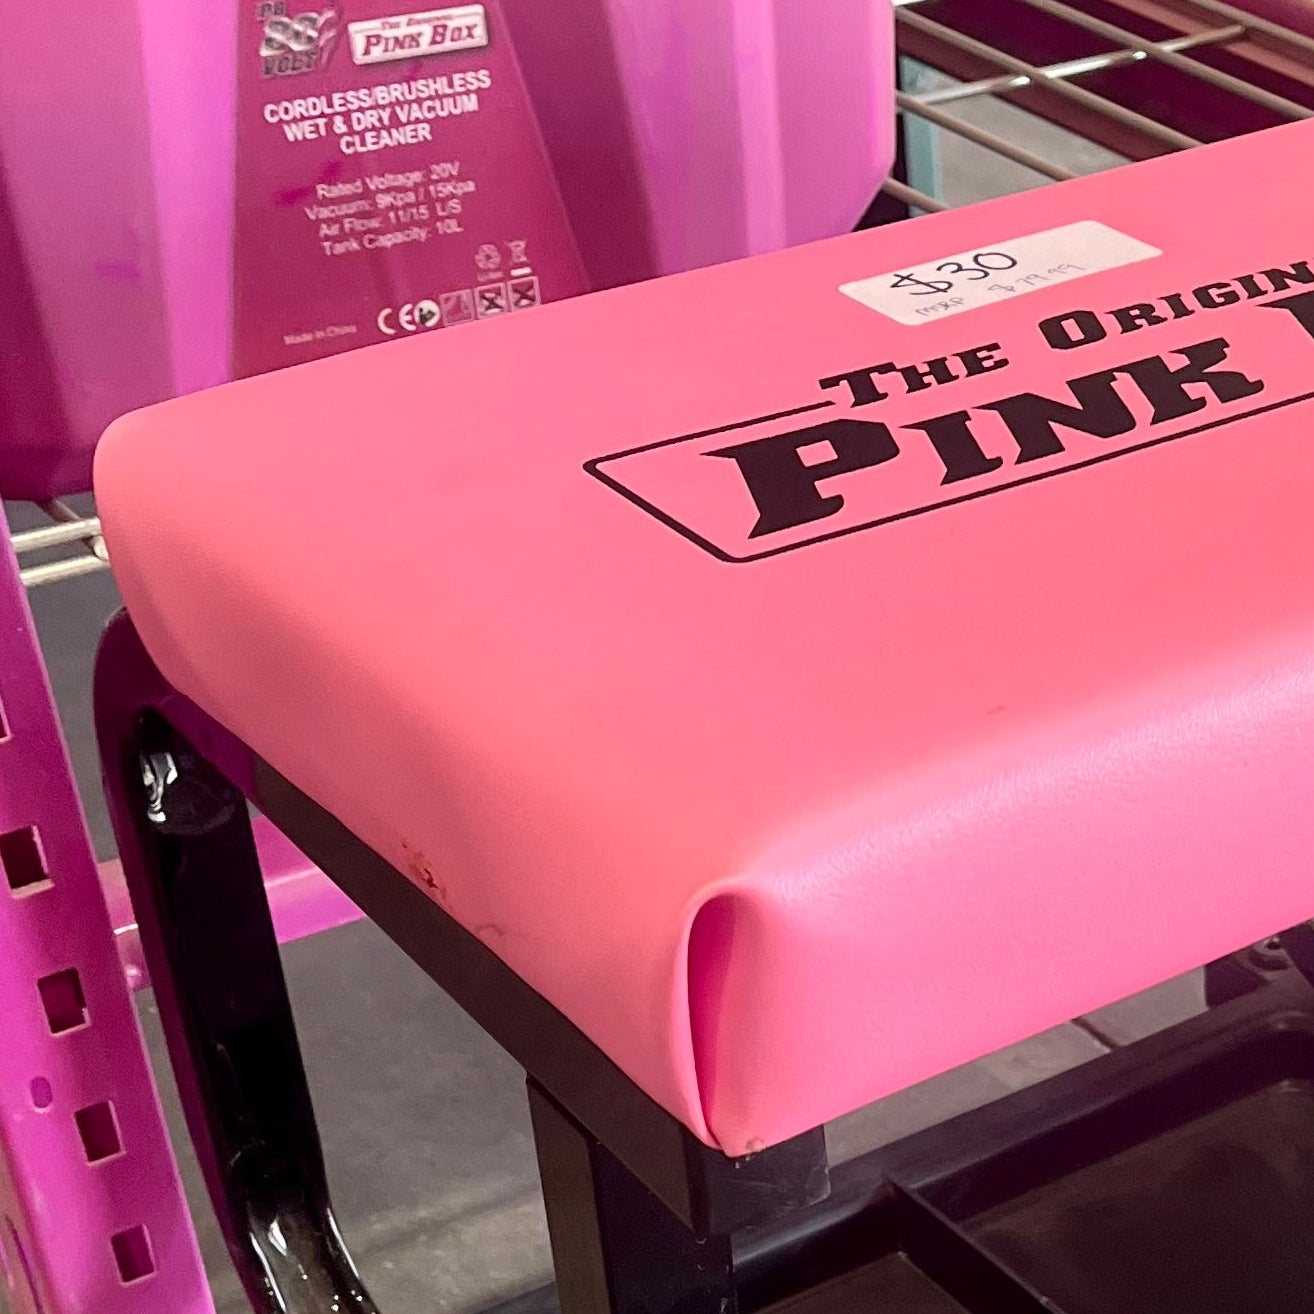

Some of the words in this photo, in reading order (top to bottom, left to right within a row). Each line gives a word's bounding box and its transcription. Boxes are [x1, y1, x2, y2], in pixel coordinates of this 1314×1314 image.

[363, 33, 423, 56] PINK
[430, 23, 478, 46] BOX
[263, 69, 492, 124] CORDLESS/BRUSHLESS
[283, 118, 327, 142] WET
[332, 115, 348, 134] &
[351, 106, 393, 132] DRY
[395, 93, 479, 123] VACUUM
[339, 122, 432, 155] CLEANER
[316, 179, 363, 200] Rated
[890, 252, 1018, 295] $30
[818, 342, 1010, 408] THE
[699, 336, 1264, 540] PINK
